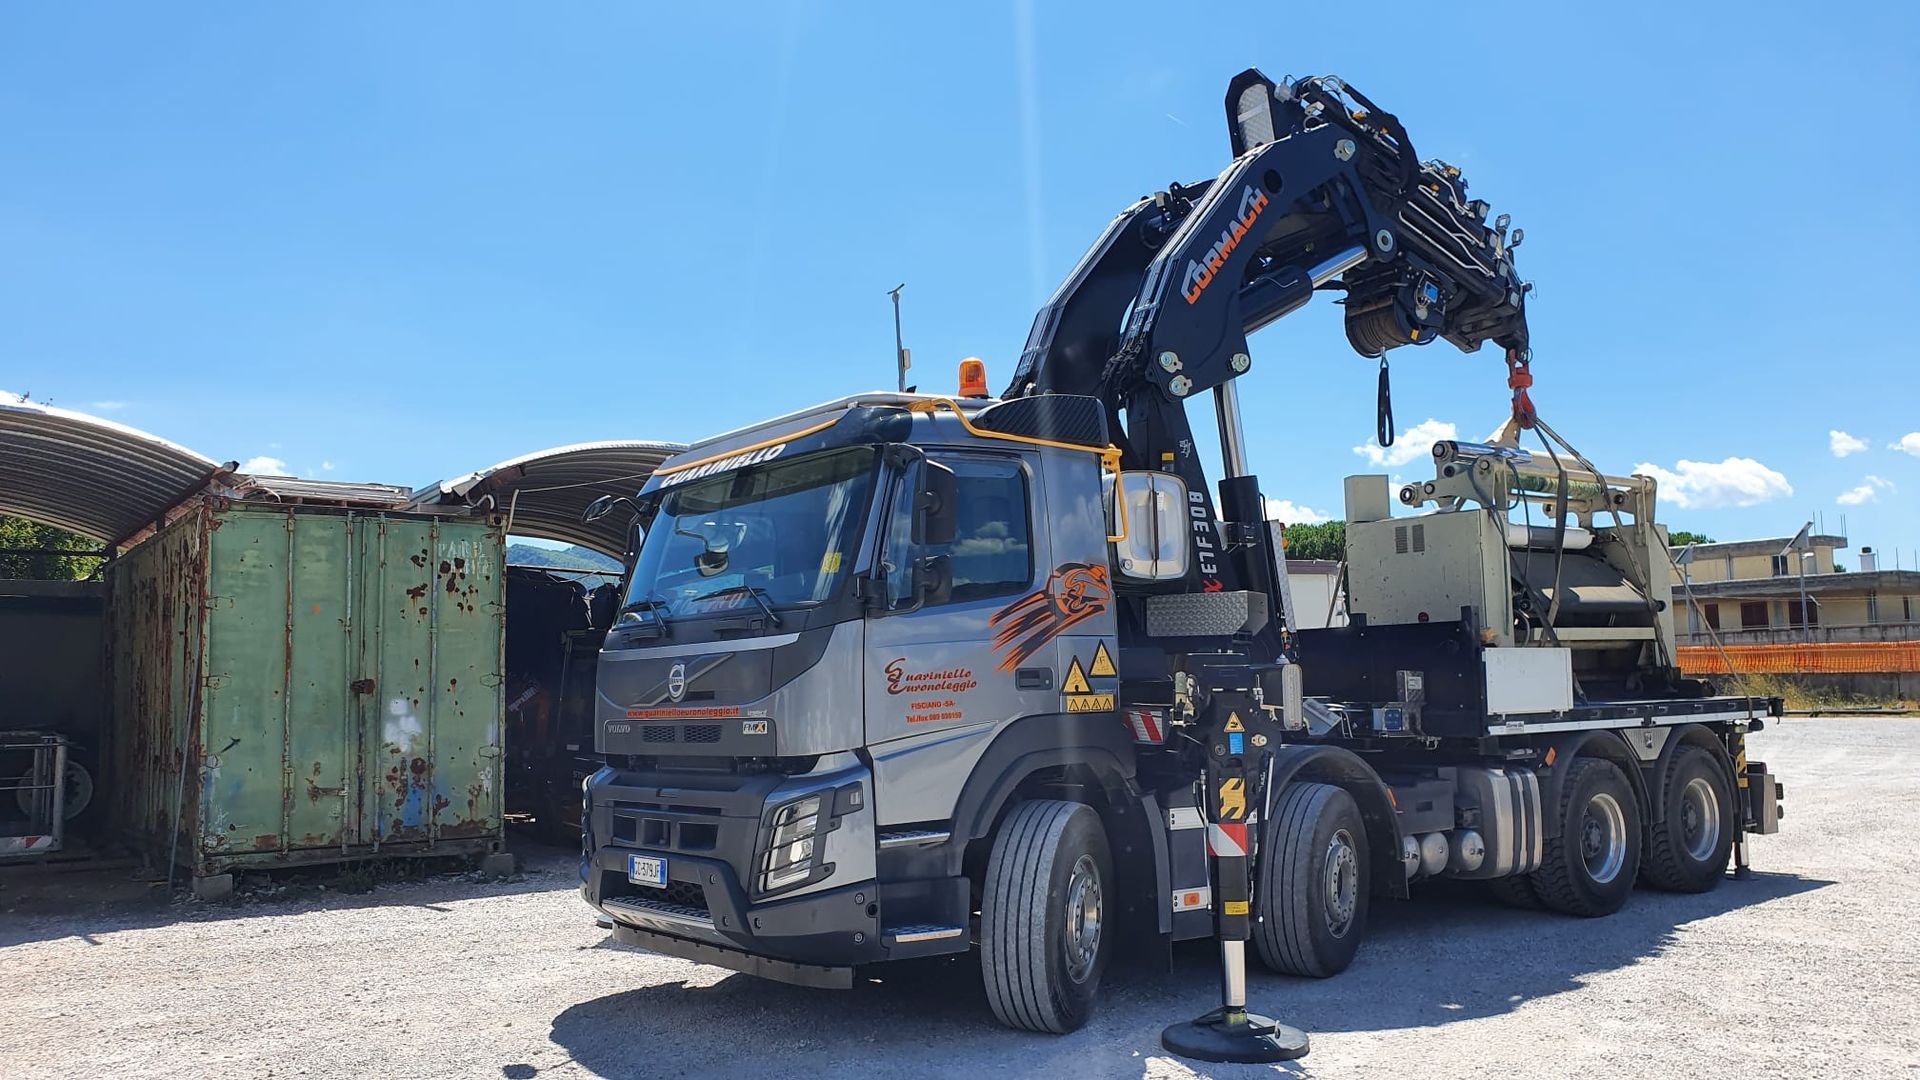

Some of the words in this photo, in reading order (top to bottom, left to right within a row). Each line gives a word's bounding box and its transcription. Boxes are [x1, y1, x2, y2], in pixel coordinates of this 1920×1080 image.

[1180, 185, 1269, 305] CORMACH
[660, 443, 786, 488] GUARINIELLO
[911, 701, 942, 710] FISCIANO
[607, 724, 631, 734] VOLVO
